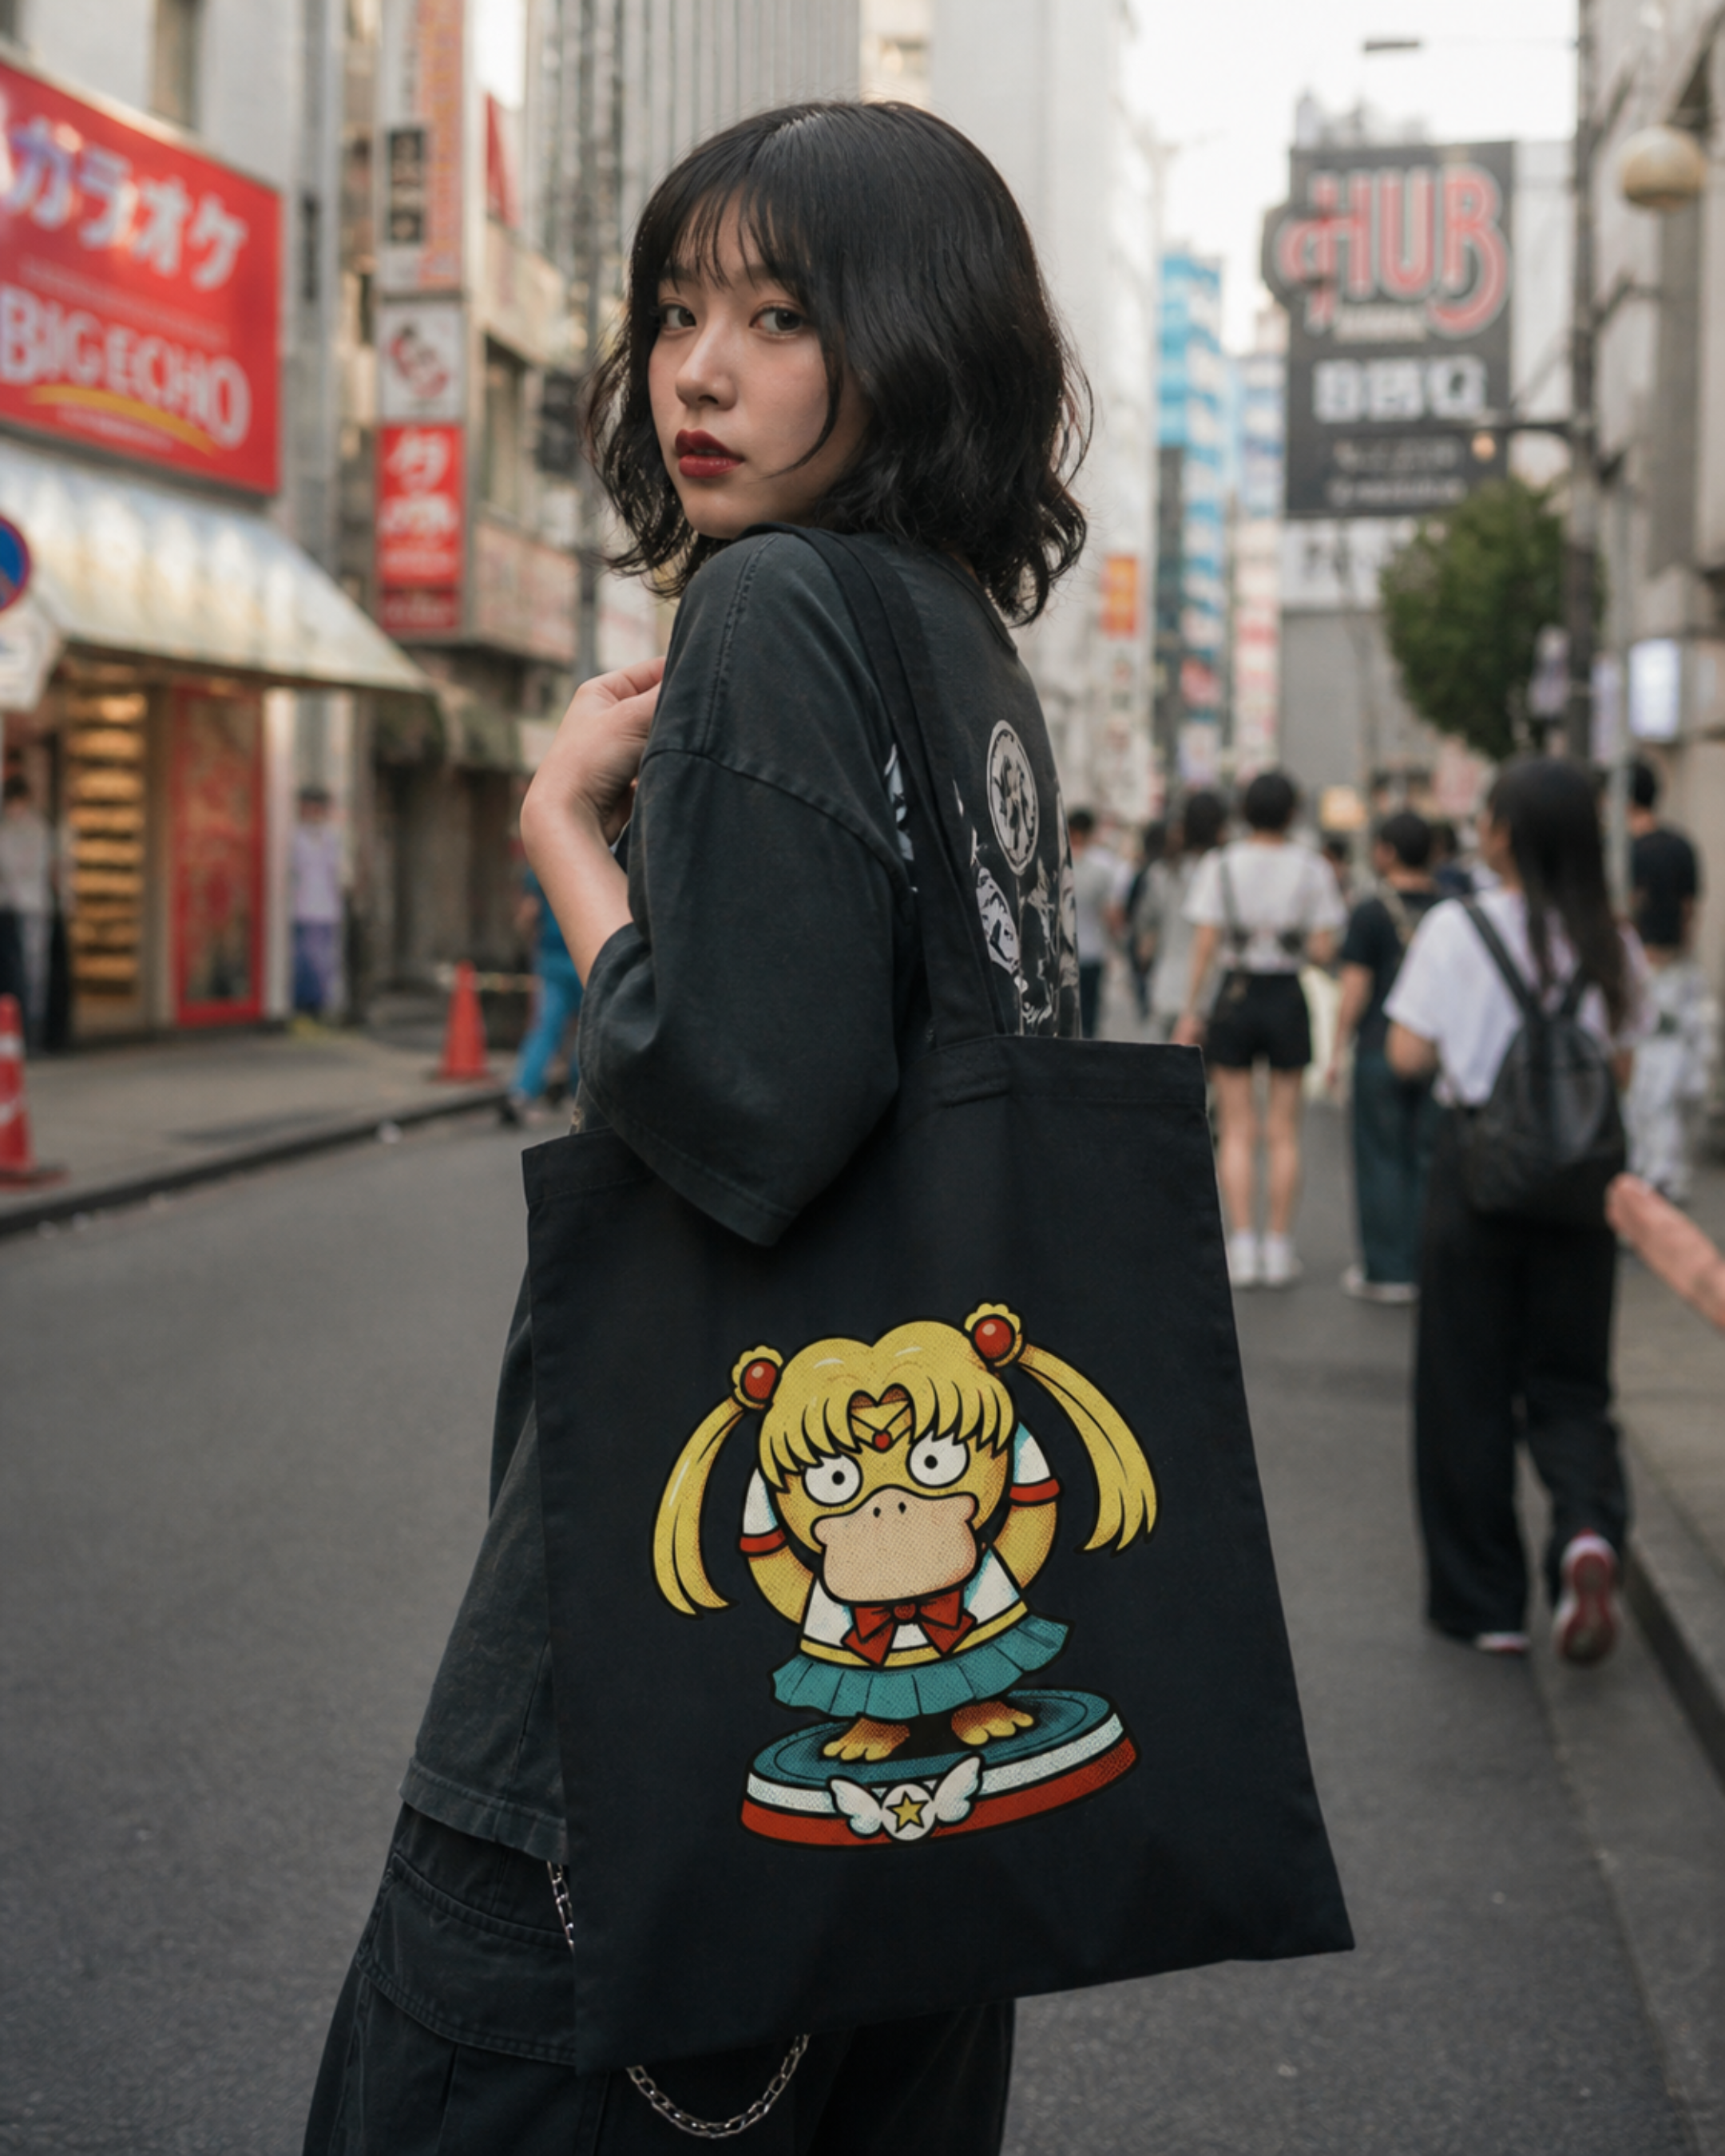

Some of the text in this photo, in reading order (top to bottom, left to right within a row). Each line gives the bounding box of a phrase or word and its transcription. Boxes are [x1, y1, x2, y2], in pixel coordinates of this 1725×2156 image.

[5, 114, 248, 289] カラオケ
[1274, 164, 1509, 339] HUB
